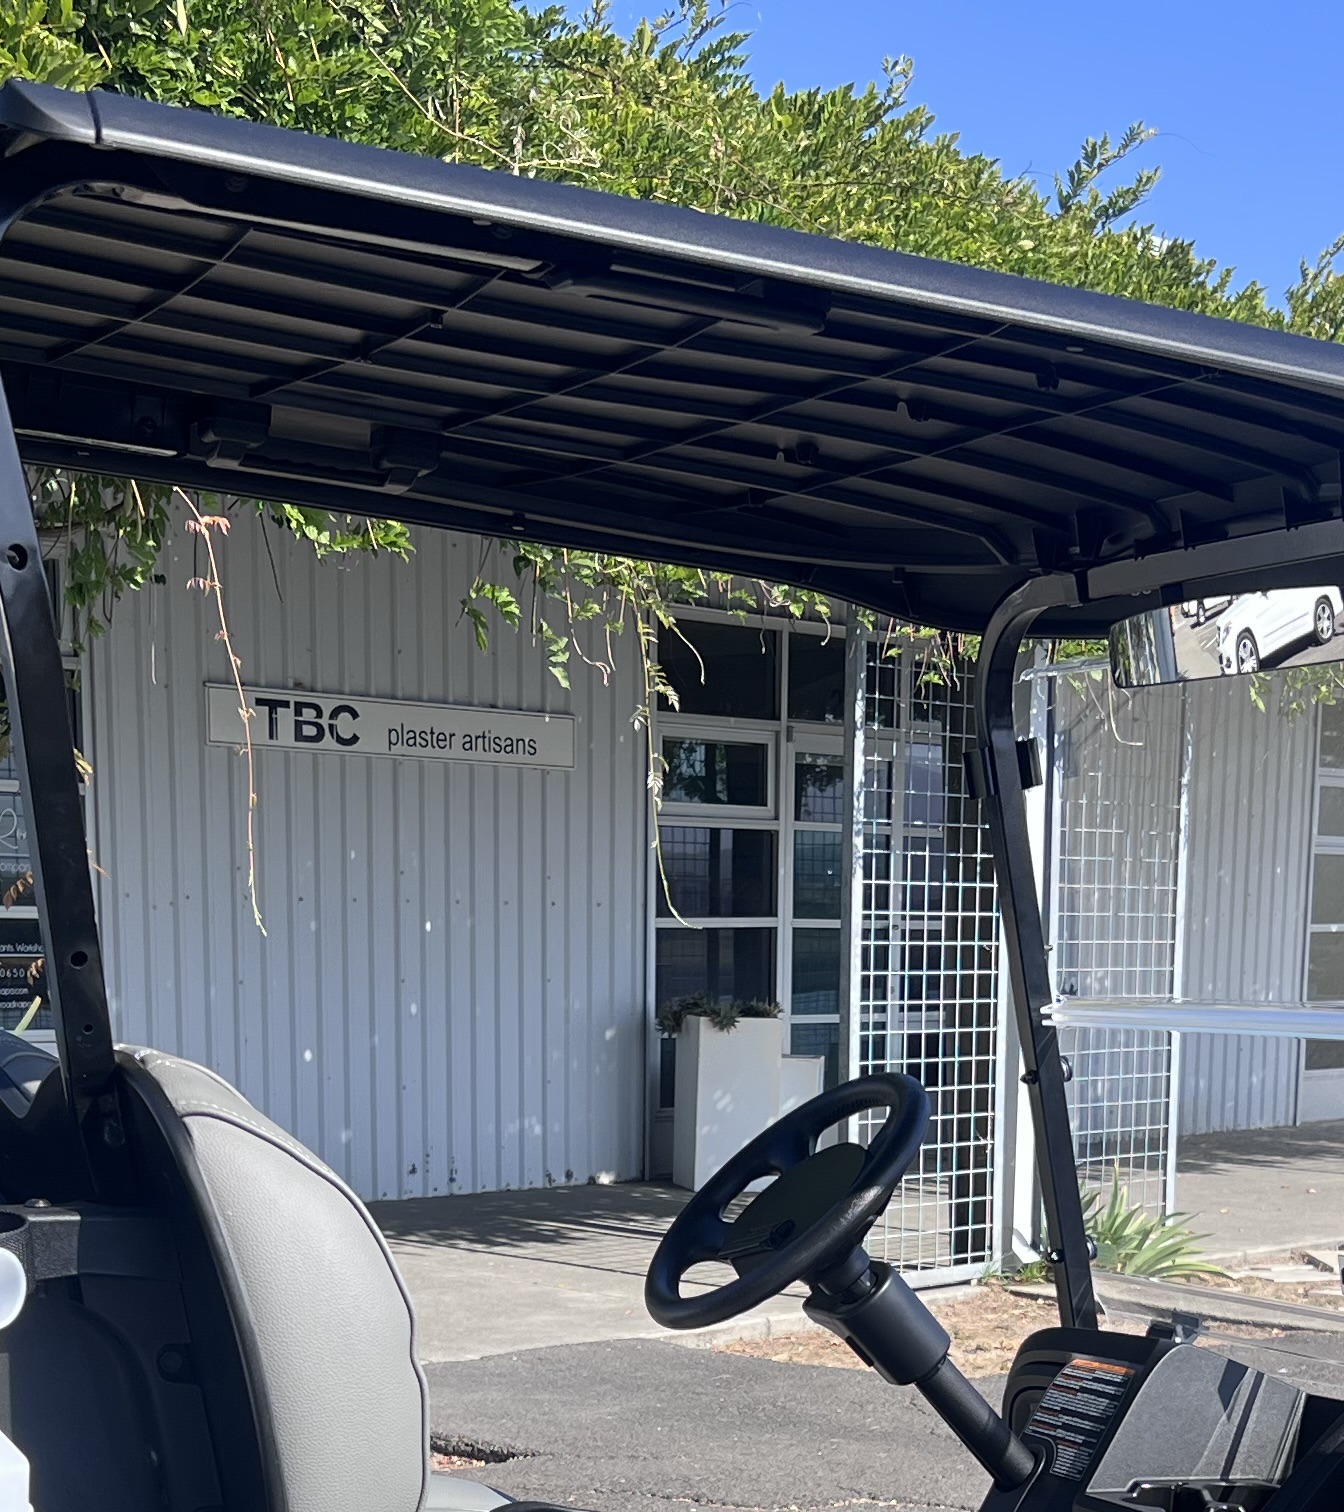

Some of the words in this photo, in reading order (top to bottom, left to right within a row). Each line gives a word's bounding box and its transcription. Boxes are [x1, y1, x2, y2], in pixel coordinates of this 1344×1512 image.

[255, 697, 361, 747] TBC
[387, 722, 456, 752] plaster
[461, 731, 538, 757] artisans
